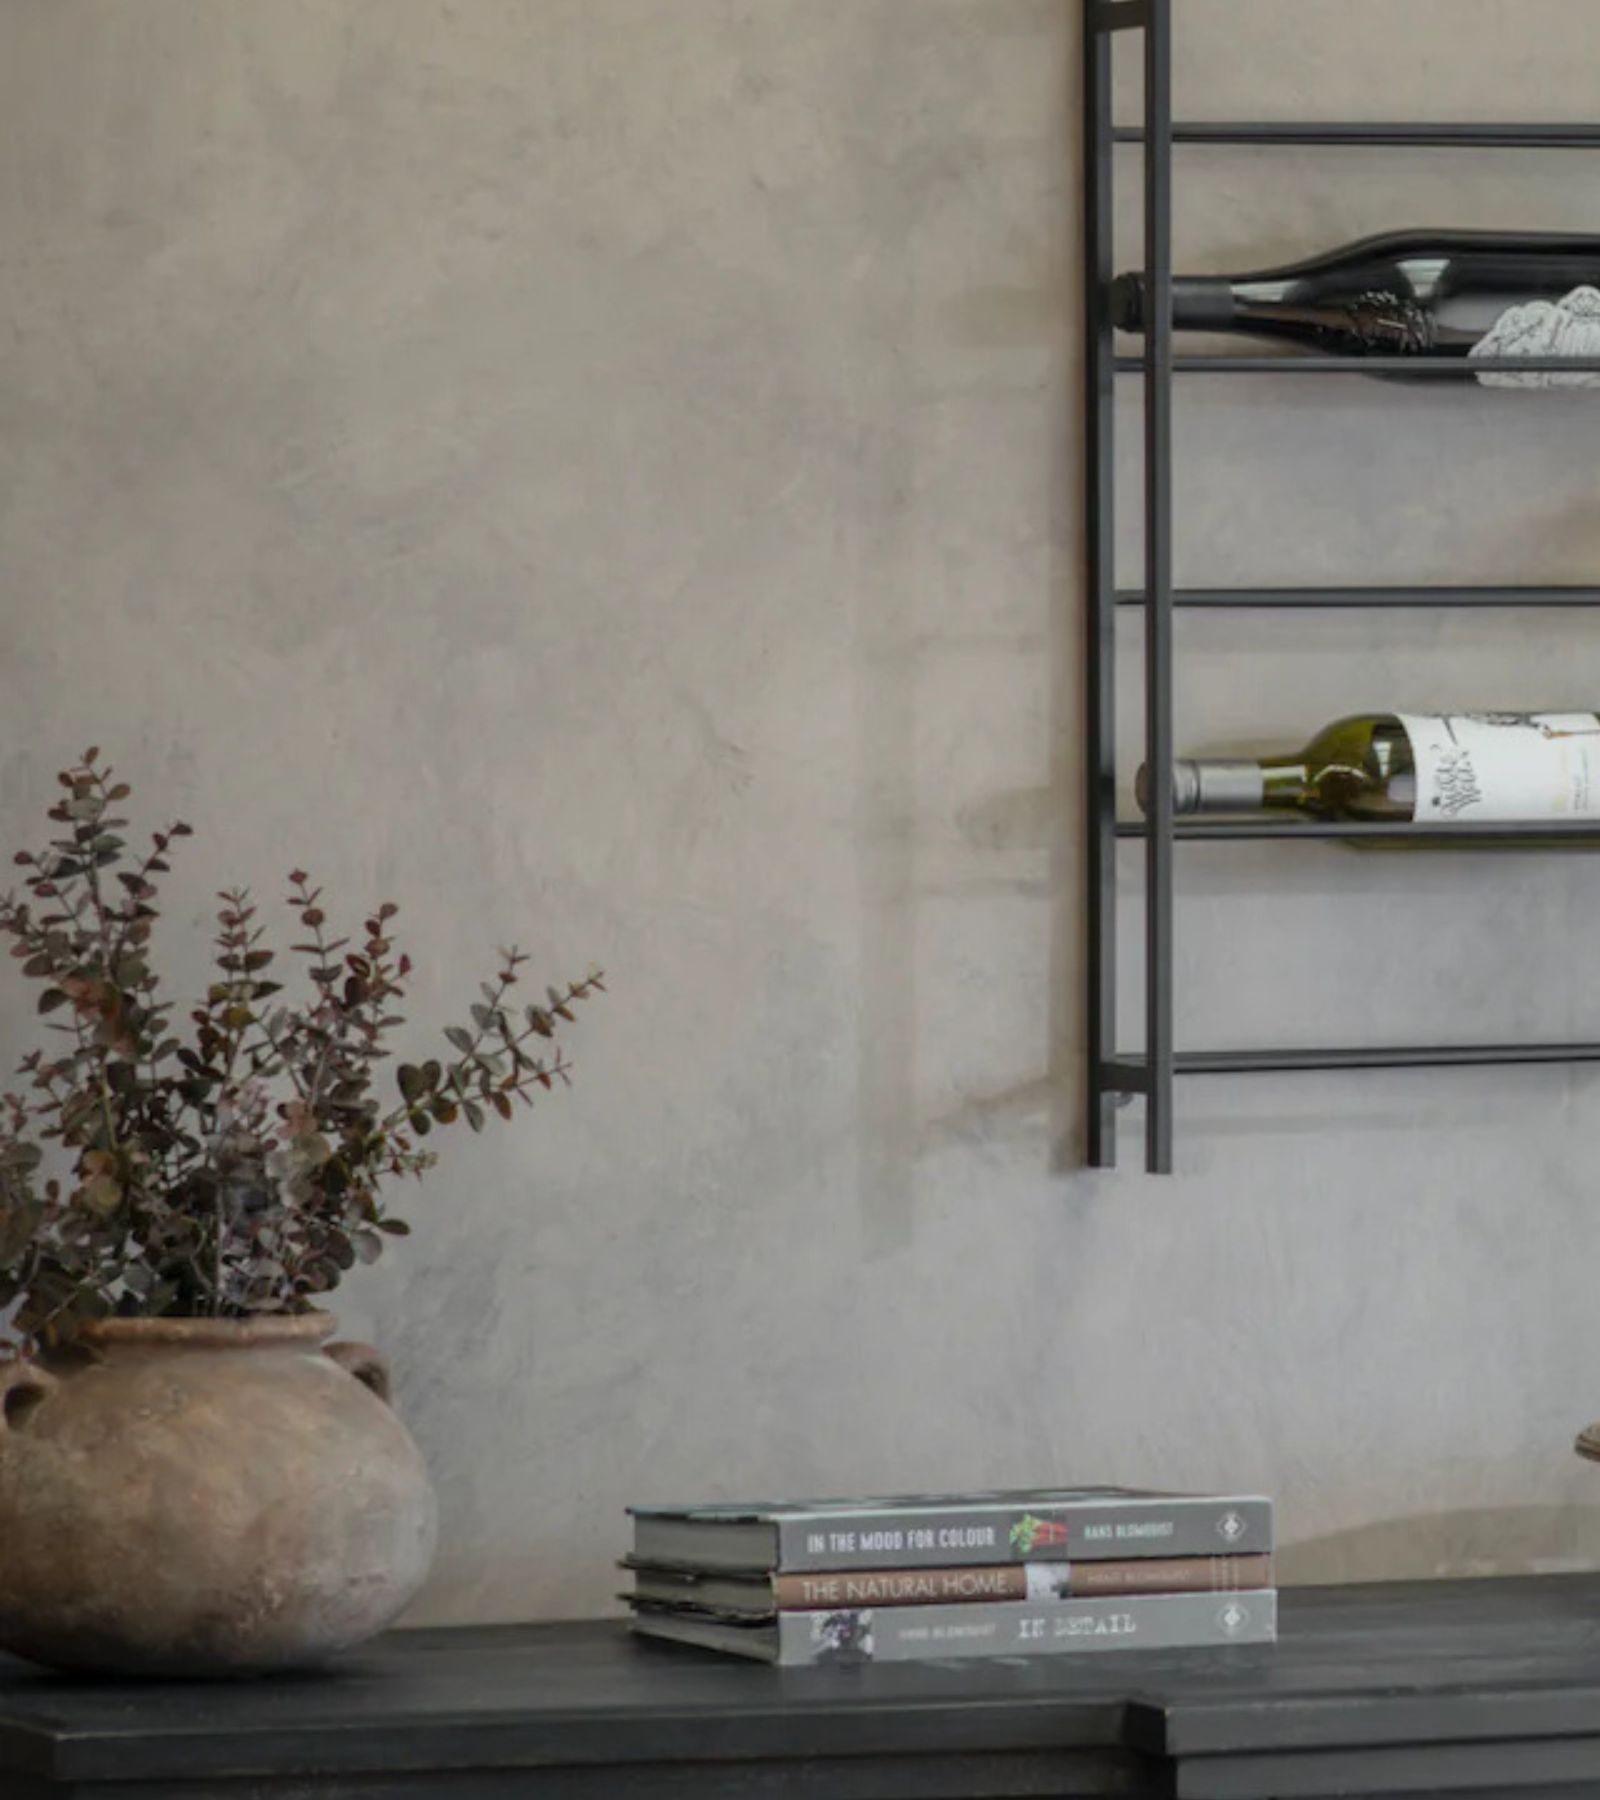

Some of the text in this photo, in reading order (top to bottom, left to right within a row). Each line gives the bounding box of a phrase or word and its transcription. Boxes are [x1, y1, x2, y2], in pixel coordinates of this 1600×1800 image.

[807, 1526, 995, 1553] IN THE MOOD FOR COLOUR
[803, 1580, 840, 1601] THE
[847, 1575, 937, 1600] NATURAL
